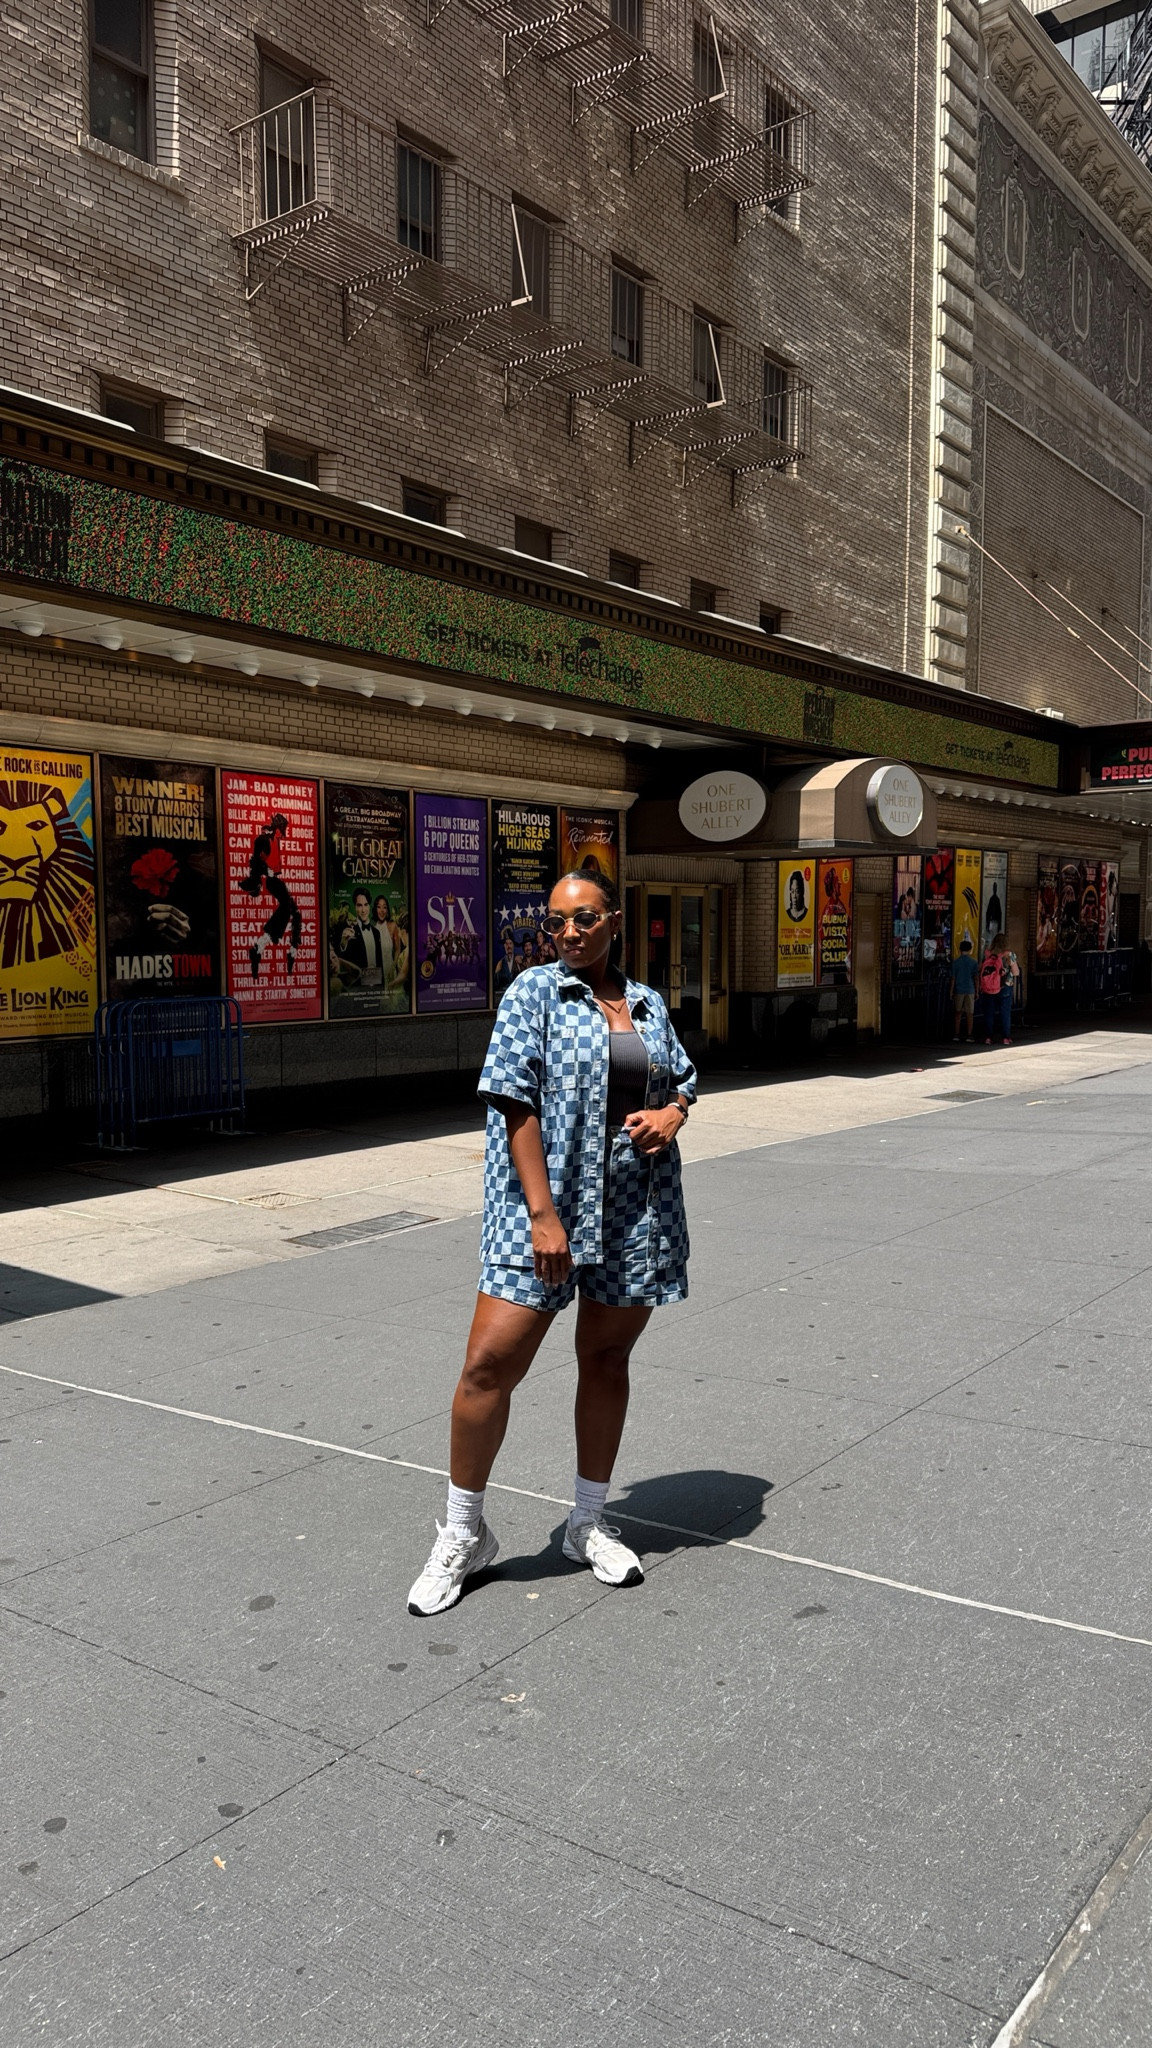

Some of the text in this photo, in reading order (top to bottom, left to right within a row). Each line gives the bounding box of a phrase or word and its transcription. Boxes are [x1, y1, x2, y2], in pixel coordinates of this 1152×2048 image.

[425, 622, 644, 692] GET TICKETS AT Telecharge
[1128, 747, 1152, 762] PU
[4, 756, 83, 779] ROCK IS CALLING
[111, 775, 205, 802] WINNER!
[226, 778, 314, 798] JAM BAD MONEY
[707, 782, 737, 798] ONE
[892, 778, 910, 792] ONE
[114, 795, 123, 812] 8
[124, 796, 155, 814] TONY
[227, 792, 314, 812] SMOOTH CRIMINAL
[691, 797, 753, 815] SHUBERT
[883, 793, 916, 809] SHUBERT
[227, 808, 248, 821] BILLIE
[249, 809, 266, 822] JEAN
[290, 813, 301, 825] YOU
[301, 815, 314, 826] BACK
[345, 815, 390, 825] EXTRAVAGANZA
[360, 808, 371, 816] BIG
[371, 809, 402, 819] BROADWAY
[888, 809, 911, 824] ALLEY
[115, 813, 207, 841] BEST MUSICAL
[228, 822, 253, 835] BLAME
[291, 827, 315, 840] BOOGIE
[423, 814, 480, 832] 1 BILLION STREAMS
[701, 815, 743, 831] ALLEY
[498, 823, 551, 840] HIGH-SEAS
[567, 826, 614, 853] Reinvented
[228, 837, 315, 853] CAN FEEL IT
[360, 837, 404, 859] GREAT
[424, 830, 480, 852] 6 POP QUEENS
[228, 851, 247, 864] THEY
[286, 855, 306, 867] ABOUT
[306, 856, 315, 868] US
[342, 856, 397, 879] GATSBY
[285, 882, 315, 894] MIRROR
[296, 895, 316, 907] ENOUGH
[230, 907, 246, 919] KEEP
[246, 908, 257, 919] THE
[822, 914, 848, 924] BUENA
[231, 921, 263, 933] BEAT
[822, 925, 847, 937] VISTA
[822, 938, 847, 949] SOCIAL
[275, 949, 284, 959] IN
[822, 951, 848, 963] CLUB
[115, 953, 212, 980] HADESTOWN
[232, 976, 269, 988] THRILLER
[286, 975, 296, 986] BE
[296, 974, 318, 986] THERE
[233, 990, 255, 1002] WANNA
[255, 990, 263, 1001] BE
[0, 1013, 47, 1021] WARD-WINNING
